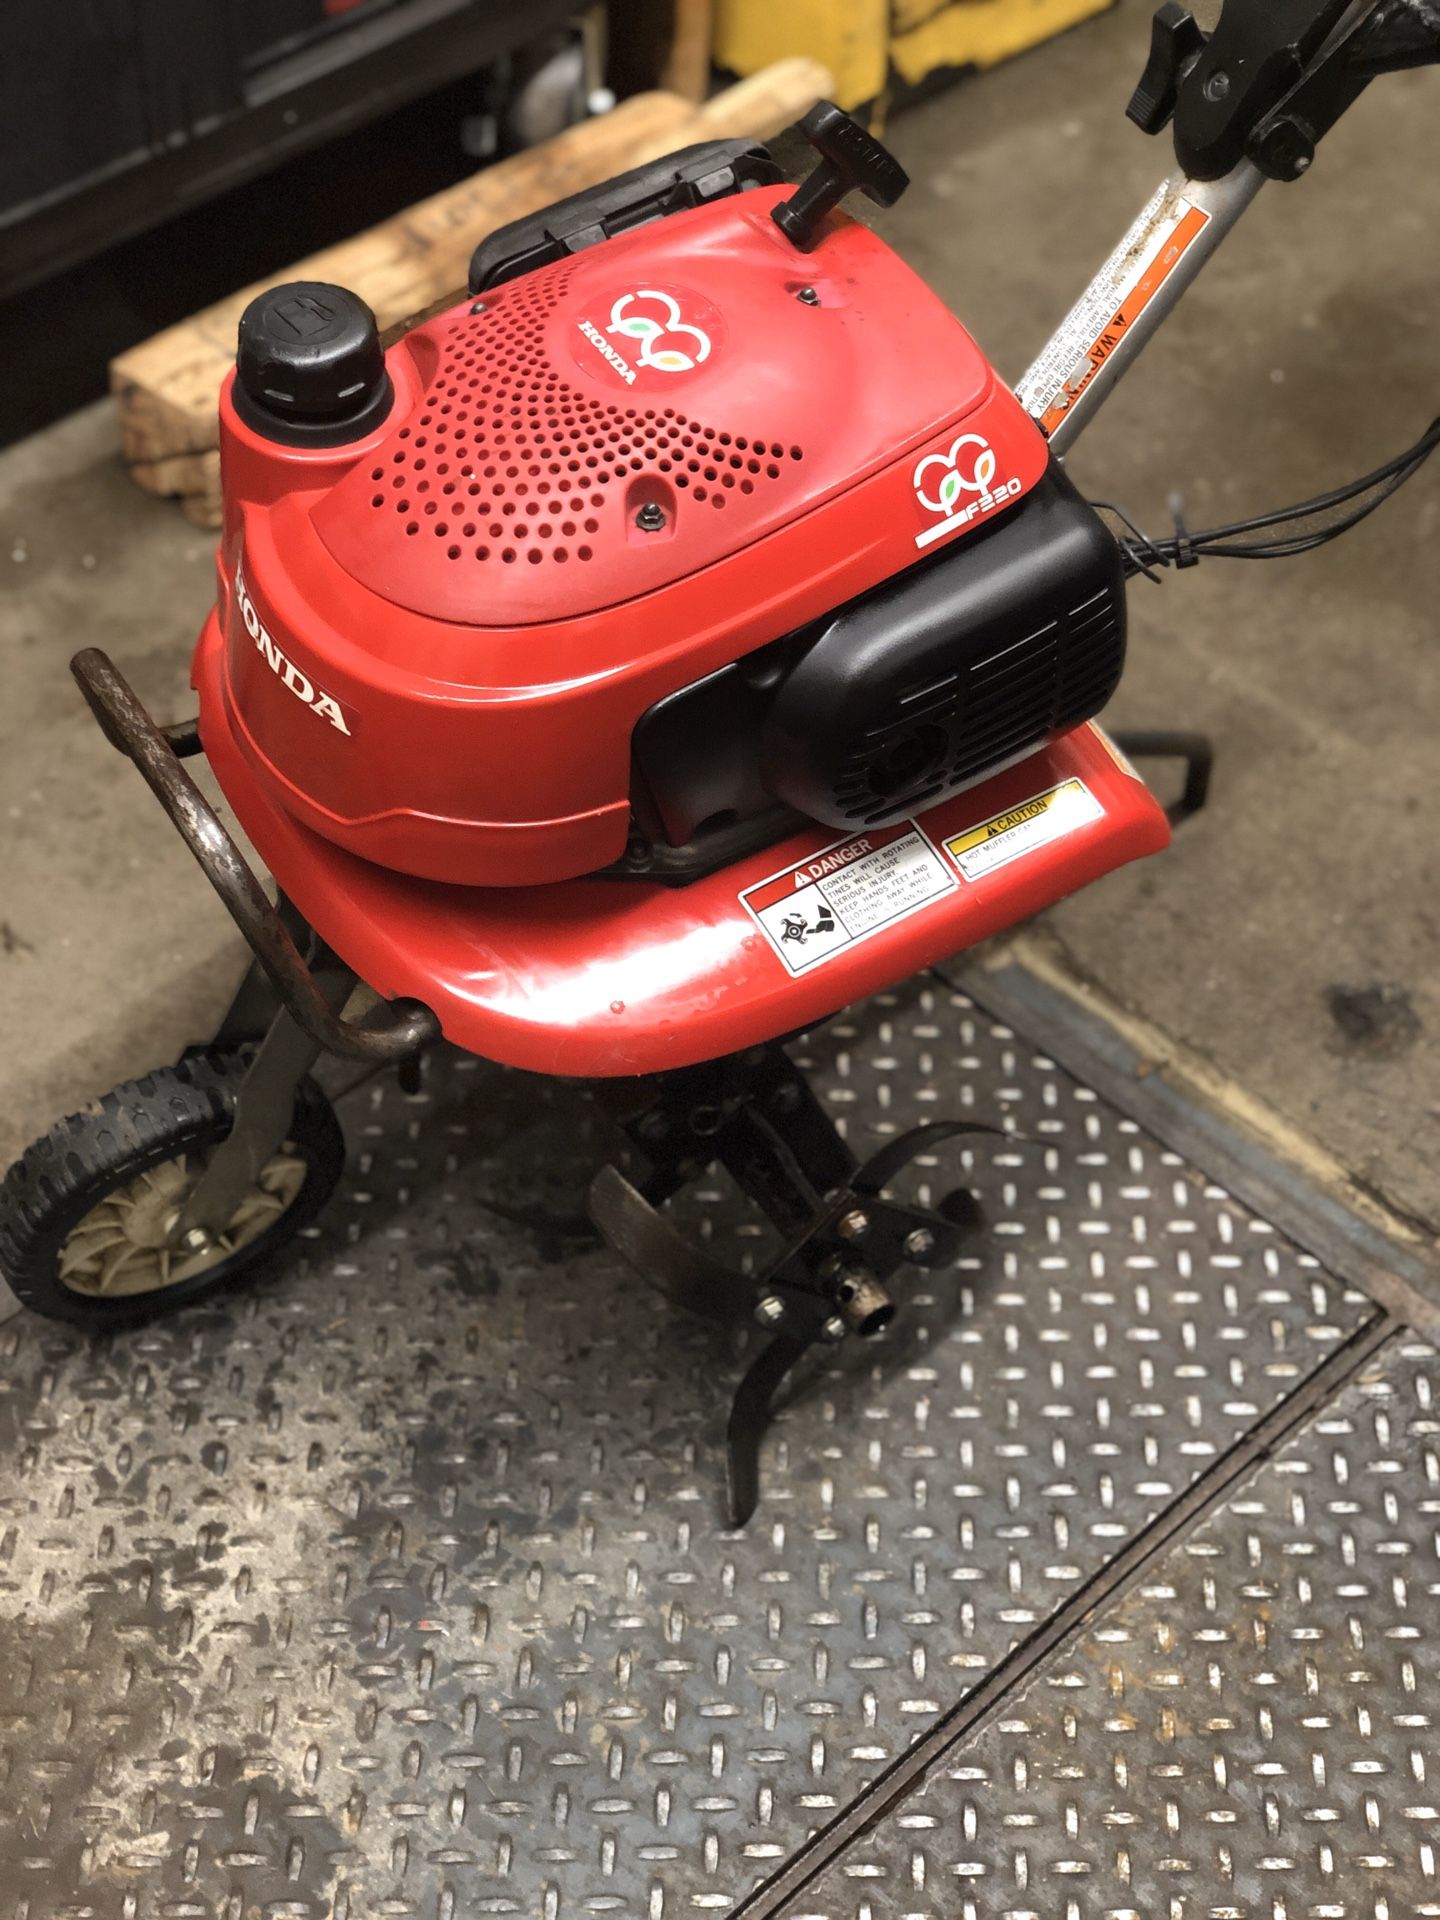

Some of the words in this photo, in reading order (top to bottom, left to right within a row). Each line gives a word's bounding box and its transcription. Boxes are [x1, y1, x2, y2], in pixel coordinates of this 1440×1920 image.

[1107, 294, 1122, 311] TO
[1087, 309, 1111, 340] AVOID
[577, 320, 637, 386] HONDA
[1058, 337, 1091, 380] SERIOUS
[1035, 376, 1063, 413] INJURY
[965, 477, 1022, 520] F220
[235, 560, 352, 736] HONDA
[995, 798, 1049, 830] CAUTION
[807, 838, 872, 878] DANGER
[820, 868, 857, 891] CONTACT
[857, 855, 880, 871] WITH
[880, 835, 920, 859] ROTATING
[964, 849, 982, 862] HOT
[981, 831, 1017, 853] MUFFLER
[826, 882, 851, 899] TINES
[852, 871, 872, 885] WILL
[872, 856, 900, 874] CAUSE
[831, 884, 866, 907] SERIOUS
[837, 899, 859, 915] KEEP
[861, 883, 889, 902] HANDS
[889, 872, 910, 887] FEET
[910, 862, 928, 876] AND
[843, 898, 883, 924] CLOTHING
[884, 886, 906, 901] AWAY
[907, 871, 933, 889] WHILE
